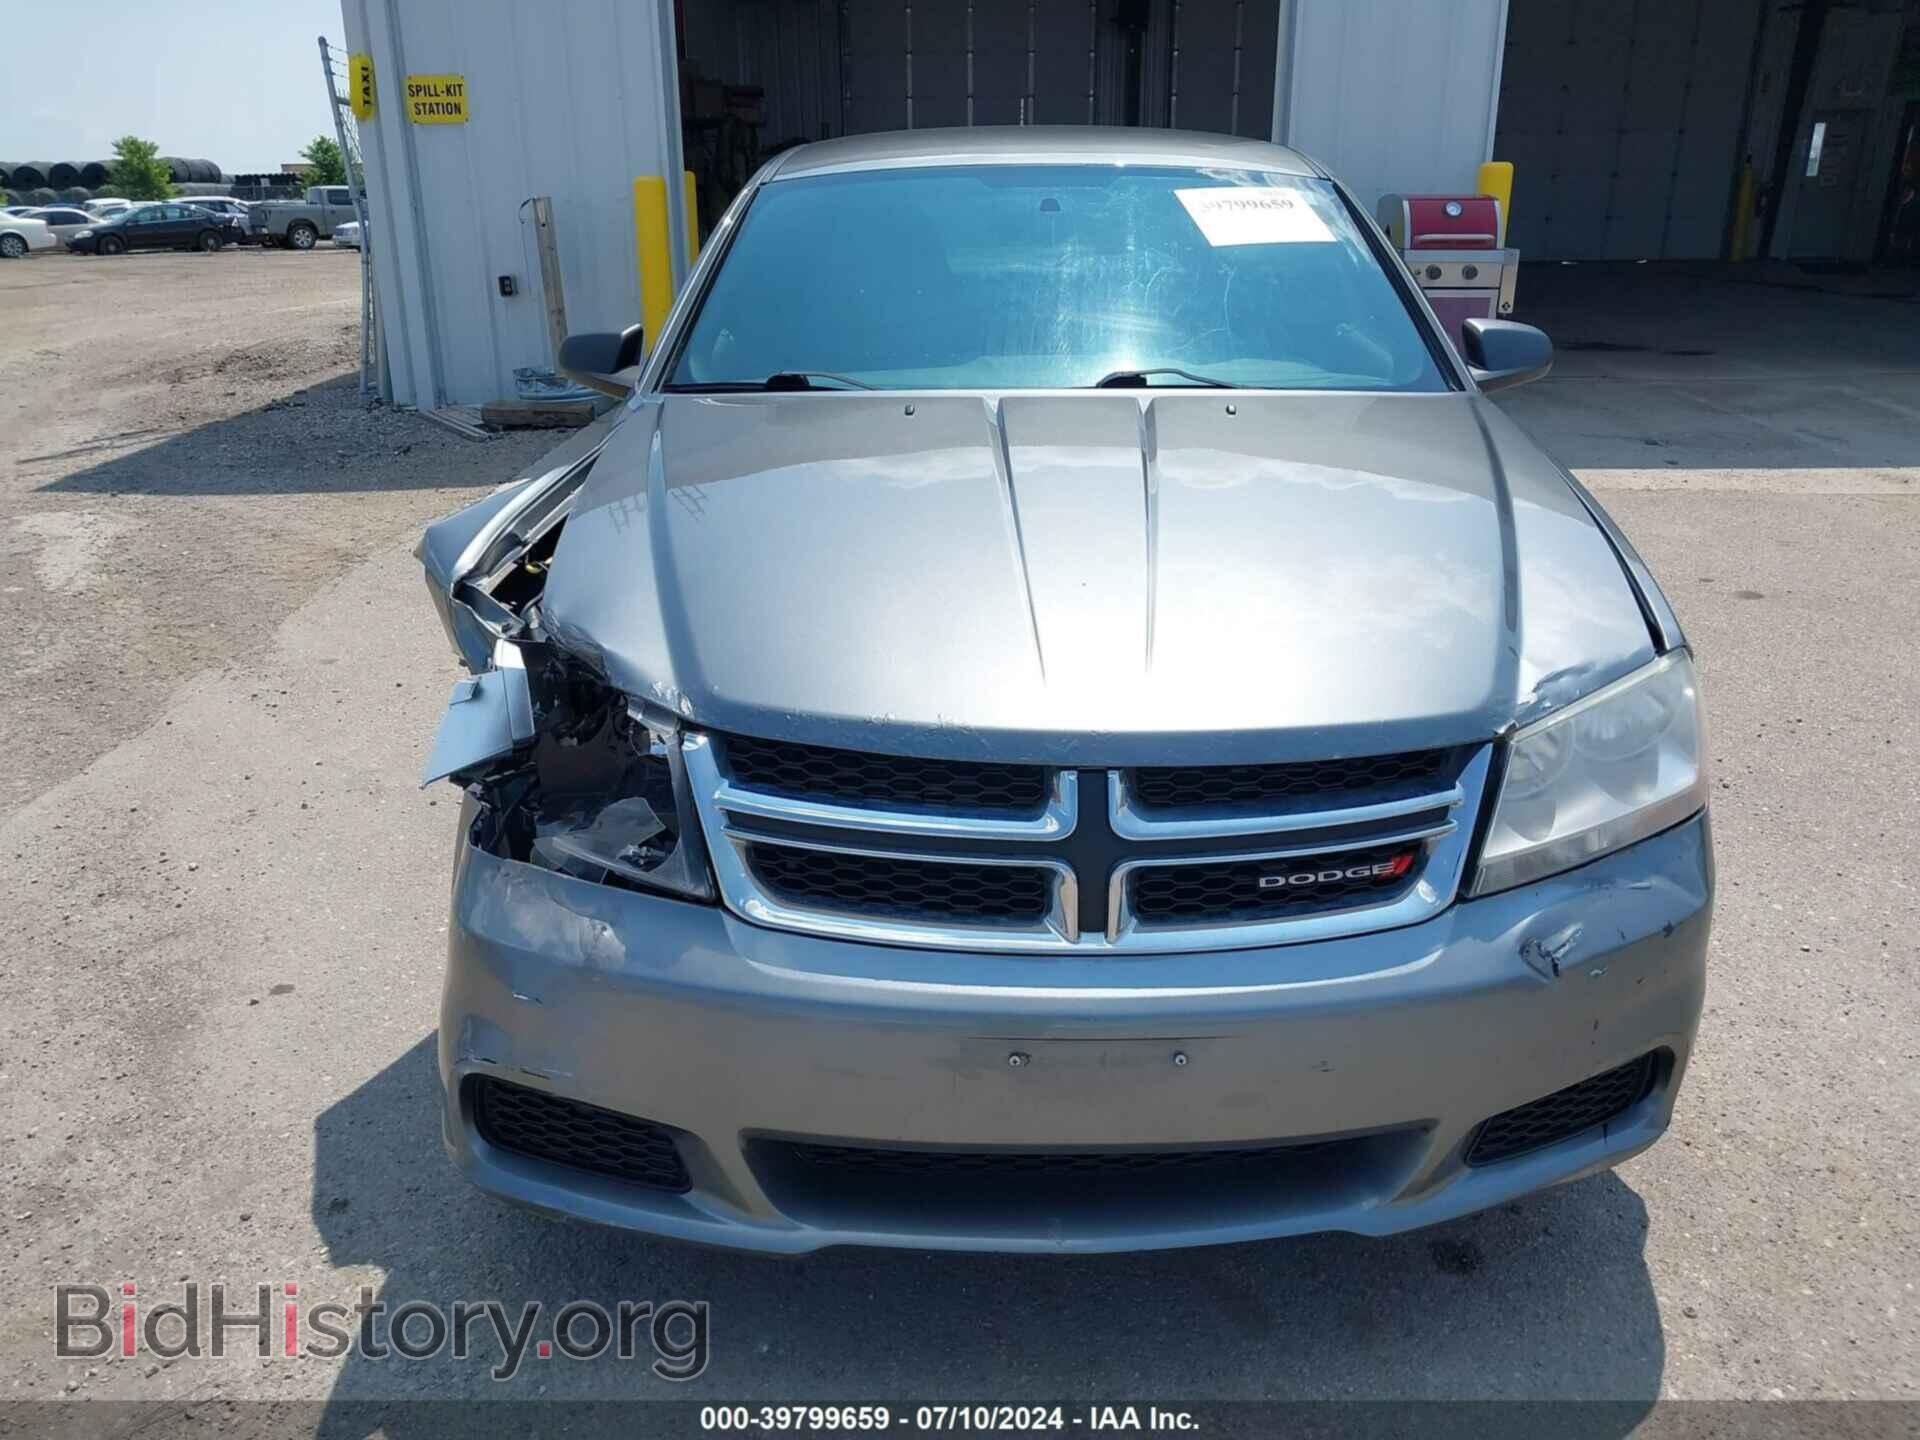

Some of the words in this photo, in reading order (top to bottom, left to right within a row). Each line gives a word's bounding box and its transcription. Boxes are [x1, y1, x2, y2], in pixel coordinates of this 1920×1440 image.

[361, 66, 371, 107] TAXI
[408, 84, 464, 97] SPILL-KIT
[414, 102, 462, 115] STATION
[1258, 861, 1395, 889] DODGE
